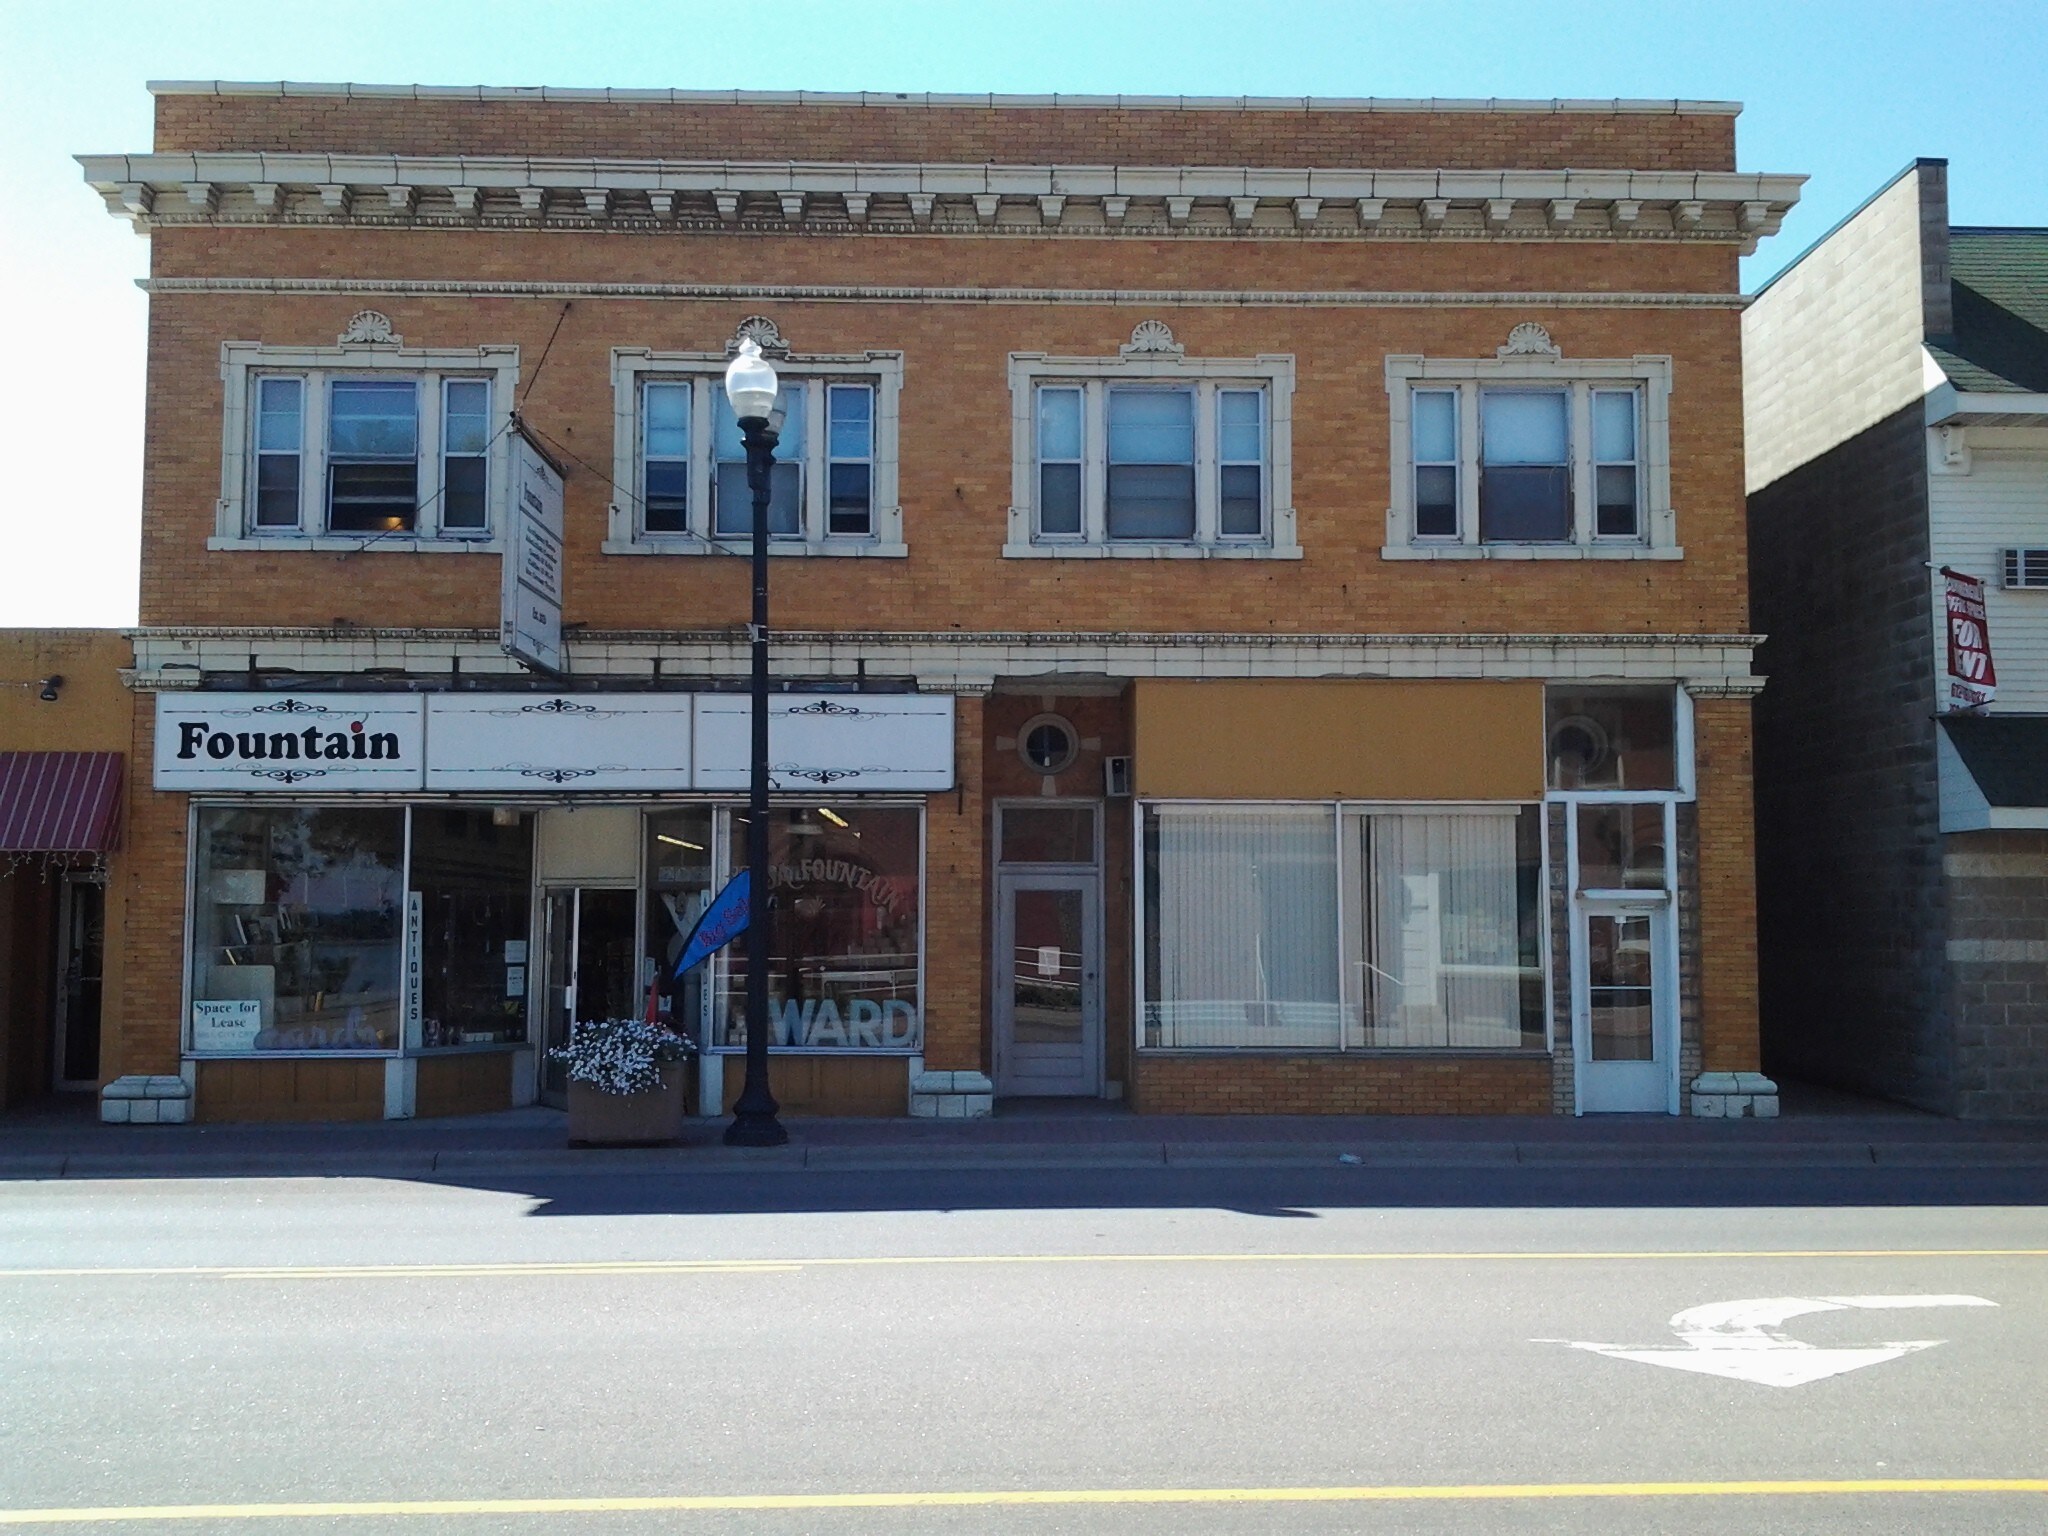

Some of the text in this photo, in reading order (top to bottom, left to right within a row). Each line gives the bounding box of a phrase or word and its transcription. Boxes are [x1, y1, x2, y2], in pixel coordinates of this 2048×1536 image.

[177, 720, 400, 760] Fountain
[800, 858, 898, 913] FOUNTAIN
[410, 898, 418, 1020] ANTIQUES
[196, 1002, 258, 1015] Space for
[211, 1016, 247, 1028] Lease
[768, 997, 917, 1048] WARD
